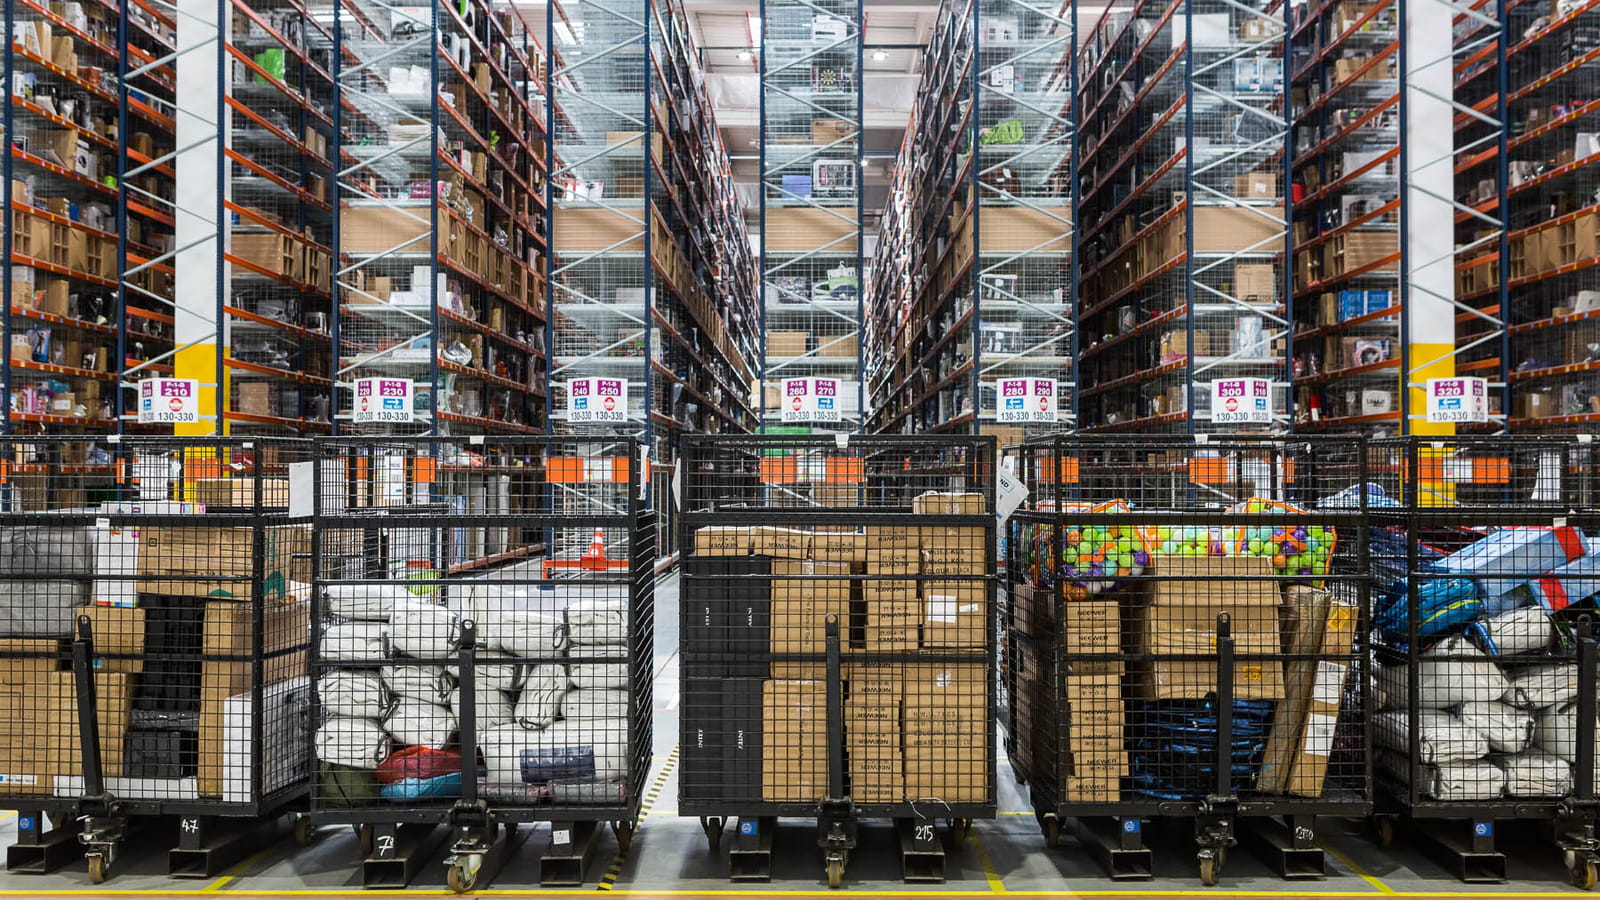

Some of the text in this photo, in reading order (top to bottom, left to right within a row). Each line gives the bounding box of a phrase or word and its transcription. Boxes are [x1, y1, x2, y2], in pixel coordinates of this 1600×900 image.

[164, 388, 188, 396] 210
[360, 388, 370, 396] 220
[383, 388, 404, 396] 230
[574, 387, 587, 396] 240
[789, 388, 805, 396] 260
[818, 387, 834, 395] 270
[1006, 388, 1024, 396] 280
[1222, 388, 1242, 396] 300
[1438, 388, 1462, 396] 320
[158, 412, 194, 421] 130-330
[378, 412, 408, 420] 130-330
[572, 411, 592, 420] 130-330
[596, 411, 624, 420] 130-330
[786, 411, 810, 420] 130-330
[814, 411, 838, 420] 130-330
[1001, 412, 1030, 420] 130-330
[1033, 411, 1054, 421] 130-330
[1216, 412, 1248, 421] 130-330
[1432, 411, 1468, 421] 130-330
[182, 819, 198, 834] 47
[916, 825, 933, 841] 215
